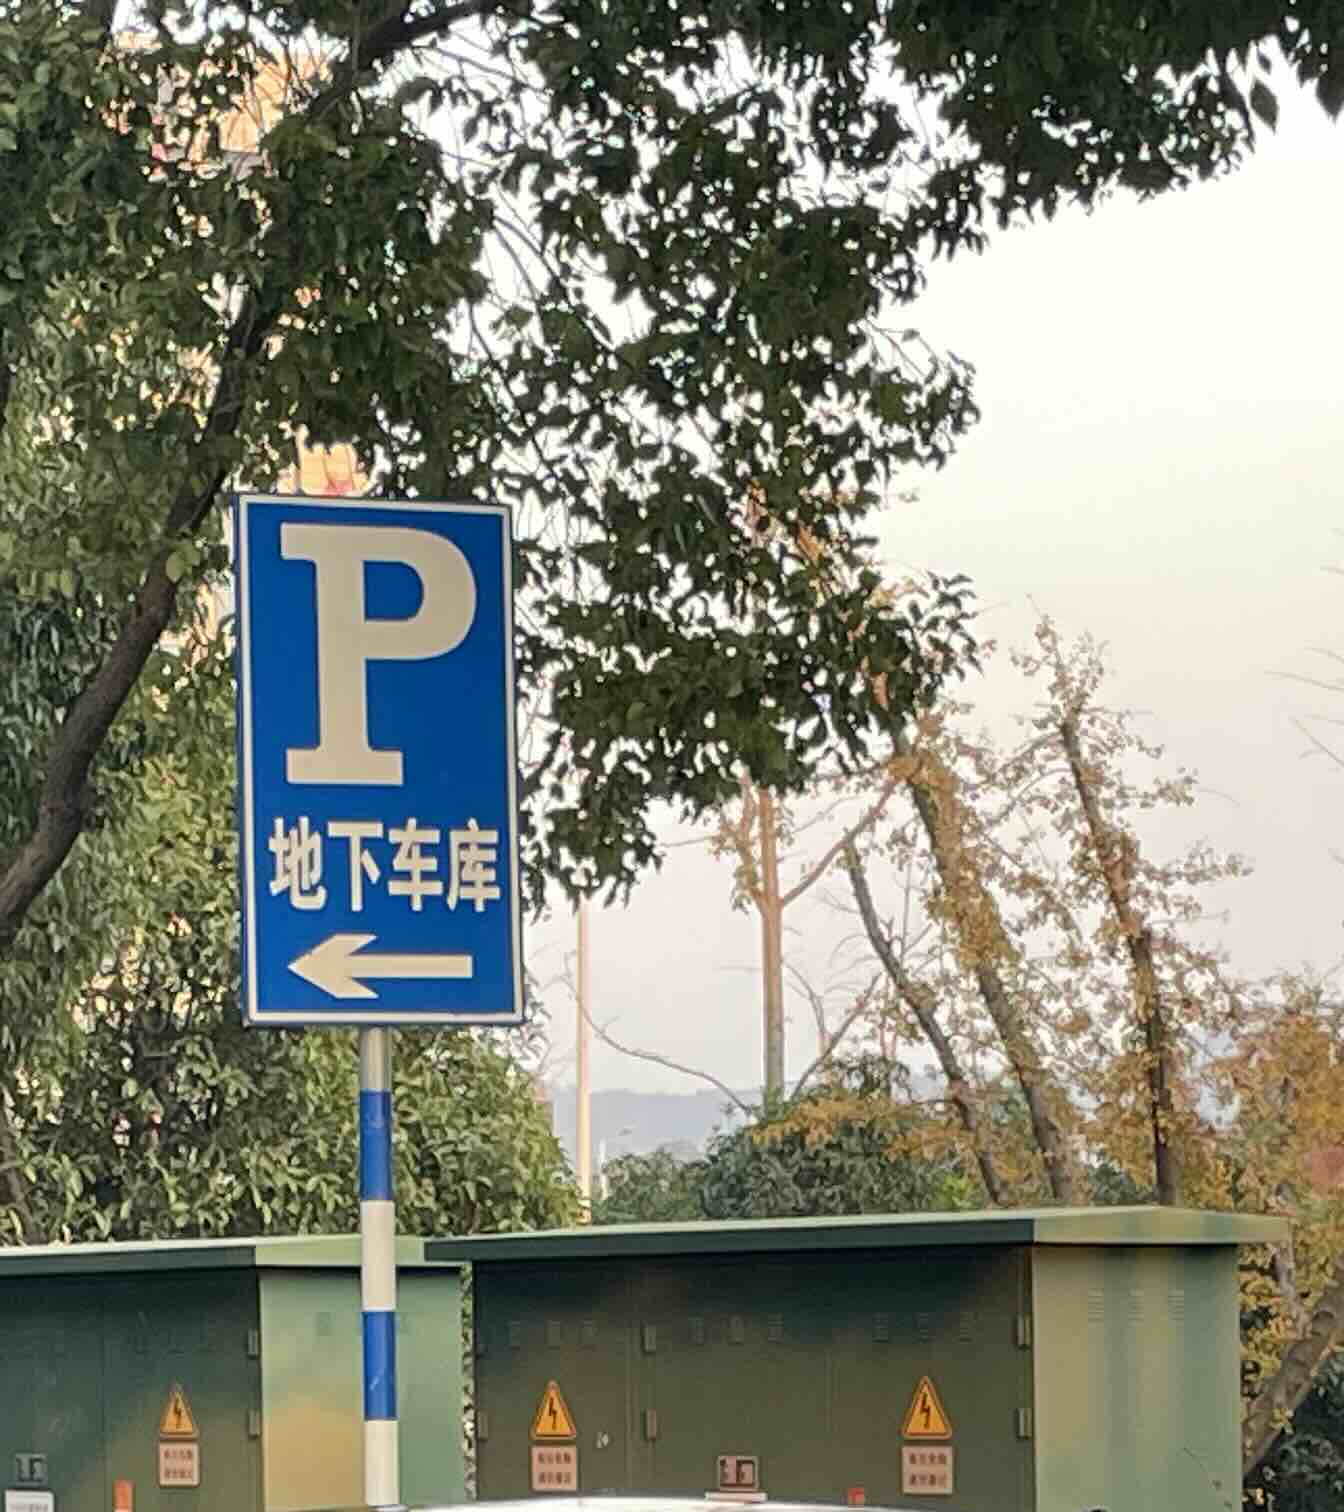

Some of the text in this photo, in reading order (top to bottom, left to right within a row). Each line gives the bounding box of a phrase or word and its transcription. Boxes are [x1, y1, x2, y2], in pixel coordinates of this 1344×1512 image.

[280, 522, 477, 786] P
[268, 817, 501, 912] 地下车库
